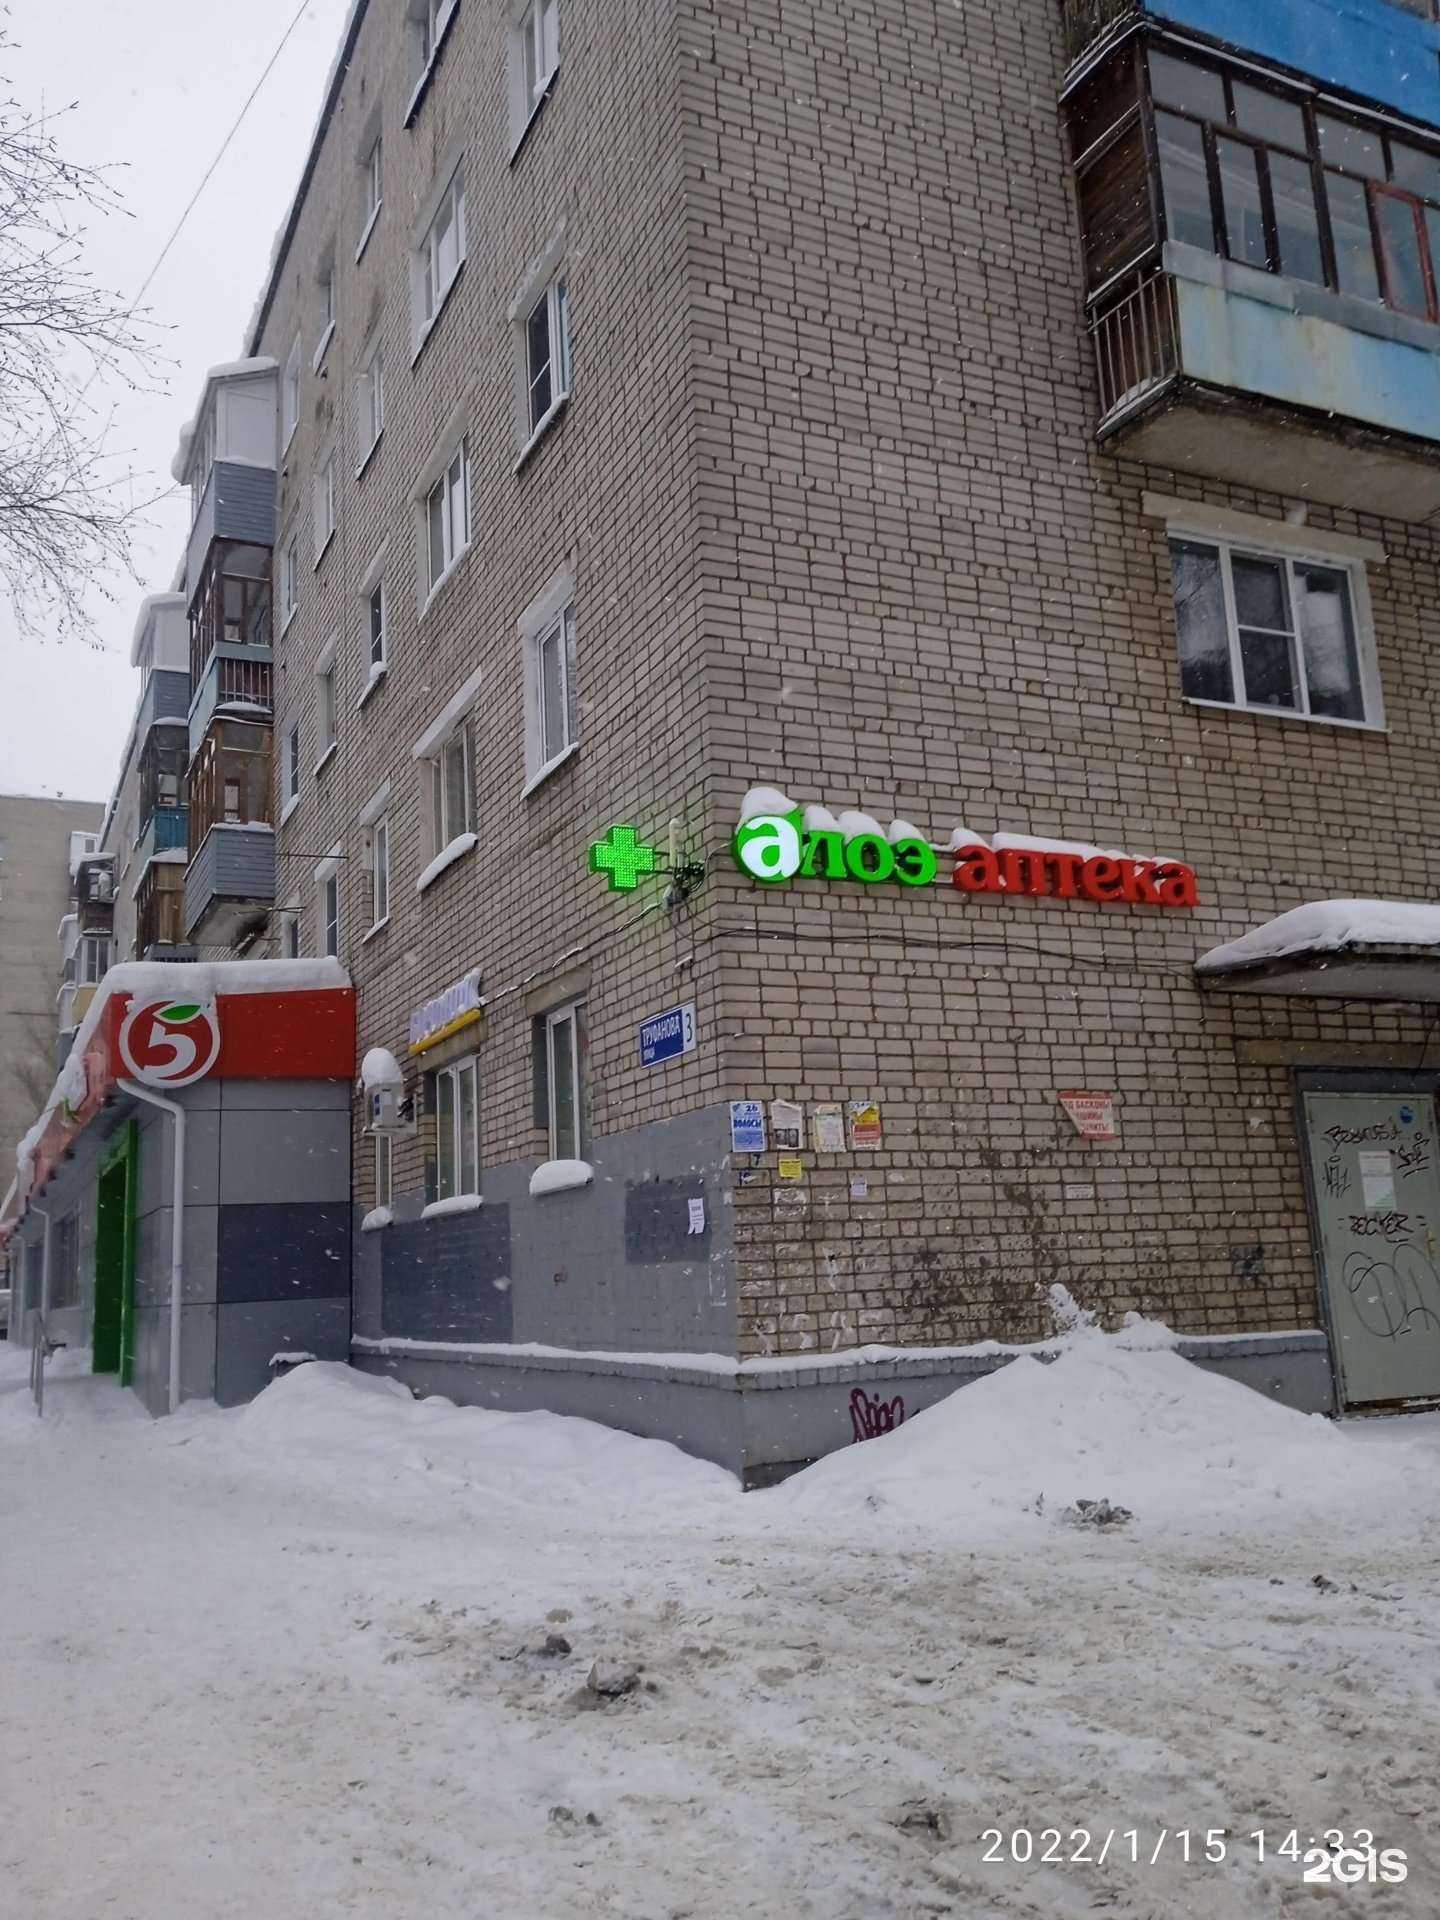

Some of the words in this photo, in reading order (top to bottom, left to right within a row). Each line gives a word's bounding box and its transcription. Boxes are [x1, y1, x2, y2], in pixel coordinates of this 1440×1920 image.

[732, 806, 937, 886] алоэ
[952, 844, 1199, 906] аптека
[642, 1015, 681, 1047] ТРУФАНОВА
[685, 1012, 693, 1043] 3
[144, 1021, 197, 1080] 5
